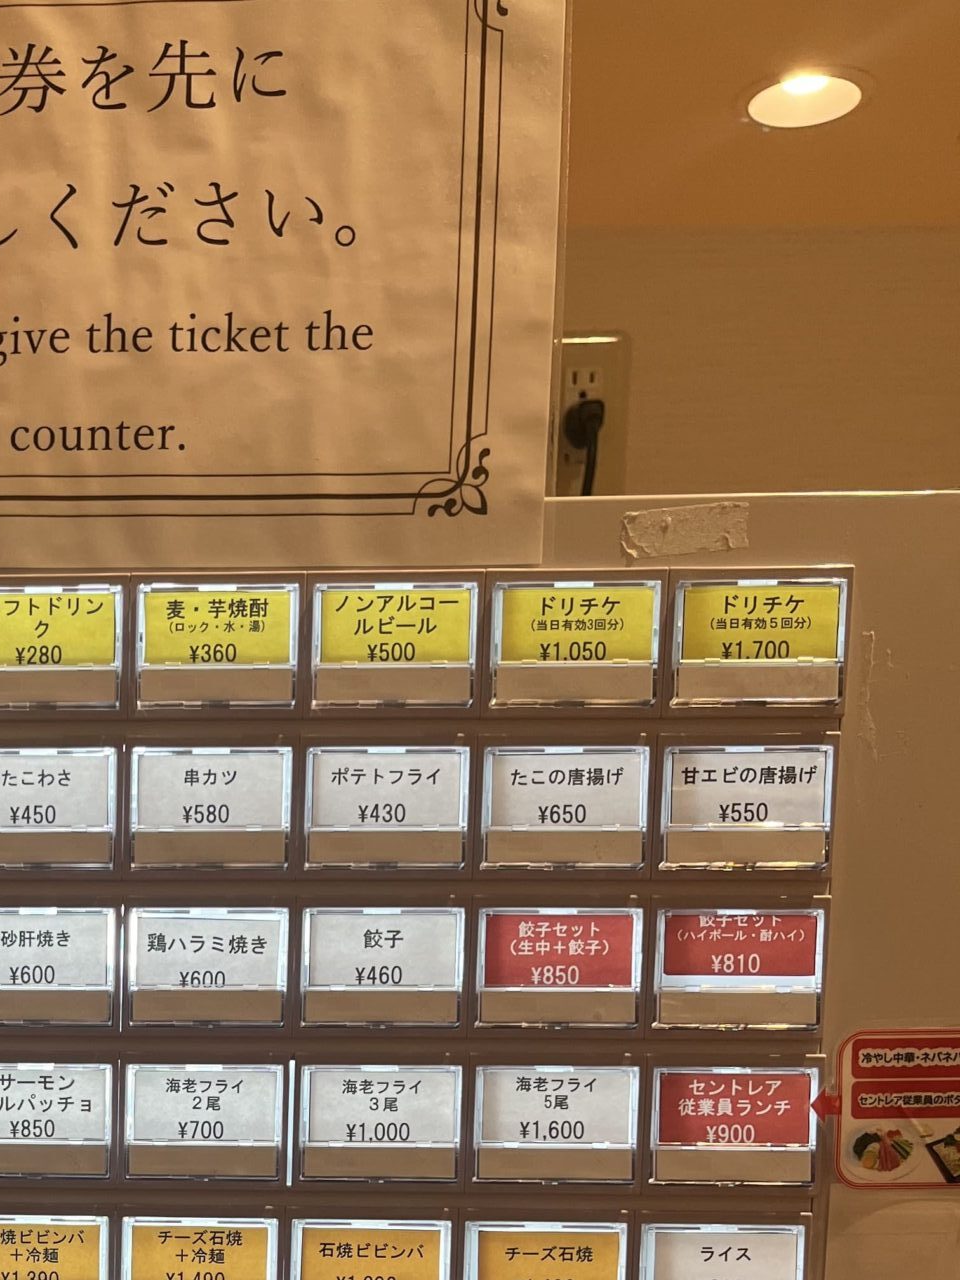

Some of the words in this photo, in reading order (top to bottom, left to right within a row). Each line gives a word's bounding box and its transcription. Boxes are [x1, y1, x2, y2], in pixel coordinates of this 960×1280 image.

[86, 314, 155, 356] the
[169, 312, 290, 354] ticket
[305, 310, 374, 353] the
[10, 420, 186, 453] counter.
[166, 598, 268, 620] 麦・芋焼酎
[542, 597, 620, 616] ドリチケ
[725, 595, 804, 614] ドリチケ
[16, 645, 62, 665] ¥280
[190, 644, 236, 664] ¥360
[368, 643, 415, 662] ¥500
[2, 769, 70, 787] たこわさ
[185, 769, 236, 786] 串カツ
[332, 768, 440, 785] ポテトフライ
[511, 767, 623, 786] たこの唐揚げ
[681, 766, 817, 785] 甘エビの唐揚げ
[10, 805, 55, 824] ¥450
[183, 805, 229, 823] ¥580
[359, 804, 407, 826] ¥430
[539, 804, 586, 823] ¥650
[719, 803, 768, 822] ¥550
[1, 930, 70, 947] 砂肝焼き
[364, 929, 403, 948] 餃子
[519, 921, 599, 937] 餃子セット
[148, 933, 267, 954] 鶏ハラミ焼き
[712, 954, 759, 973] ¥810
[9, 964, 56, 984] ¥600
[355, 964, 404, 986] ¥460
[532, 966, 579, 984] ¥850
[166, 1078, 243, 1093] 海老フライ
[343, 1079, 421, 1094] 海老フライ
[516, 1077, 596, 1092] 海老フライ
[689, 1079, 781, 1096] セントレア
[679, 1098, 790, 1116] 従業員ランチ
[9, 1118, 56, 1138] ¥850
[177, 1119, 225, 1140] ¥700
[707, 1123, 757, 1144] ¥900
[158, 1230, 242, 1246] チーズ石焼
[319, 1242, 424, 1258] 石焼ビビンバ
[505, 1246, 593, 1262] チーズ石焼
[701, 1247, 751, 1262] ライス
